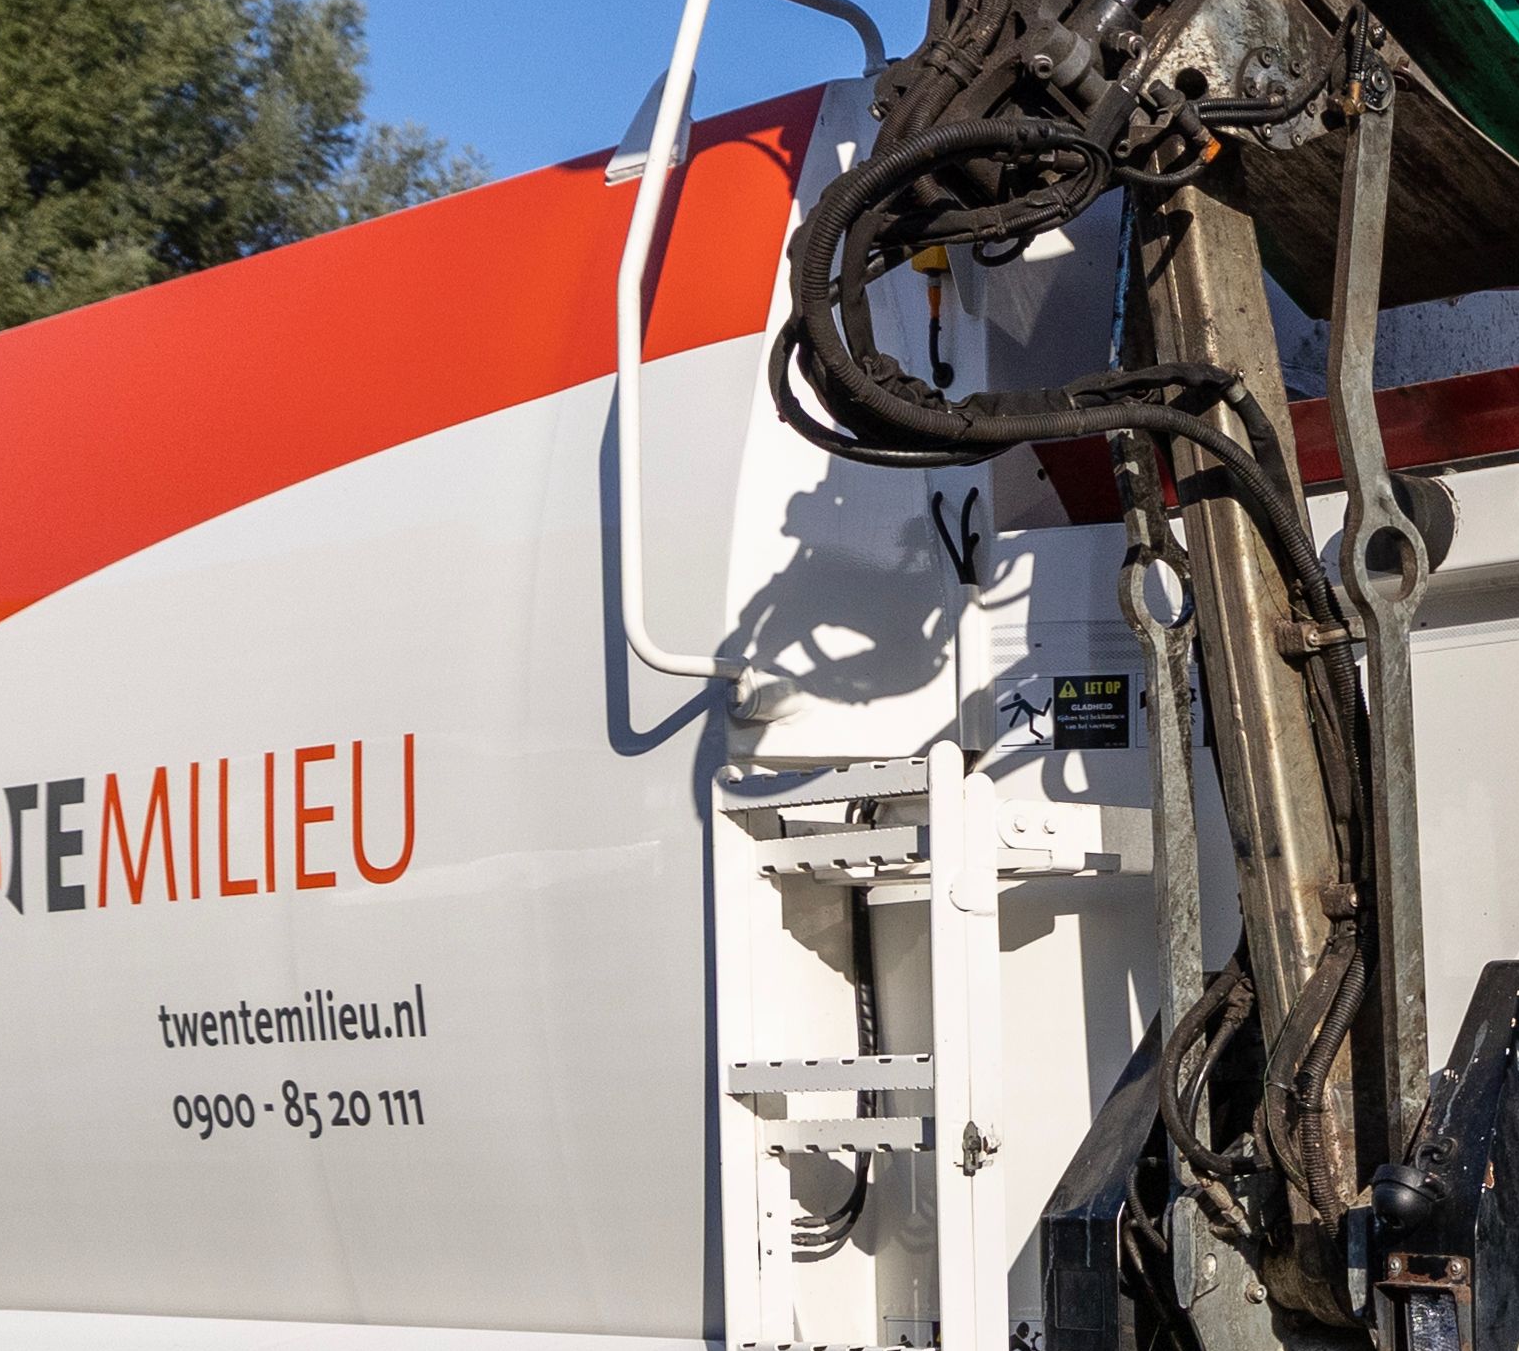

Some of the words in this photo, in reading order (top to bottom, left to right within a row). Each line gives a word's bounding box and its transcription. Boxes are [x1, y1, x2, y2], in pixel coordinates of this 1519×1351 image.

[1085, 682, 1102, 695] LET
[1105, 681, 1121, 695] OP
[158, 983, 427, 1048] twentemilieu.nl
[173, 1092, 256, 1140] 0900
[282, 1079, 323, 1139] 85
[328, 1090, 371, 1127] 20
[378, 1089, 425, 1126] 111
